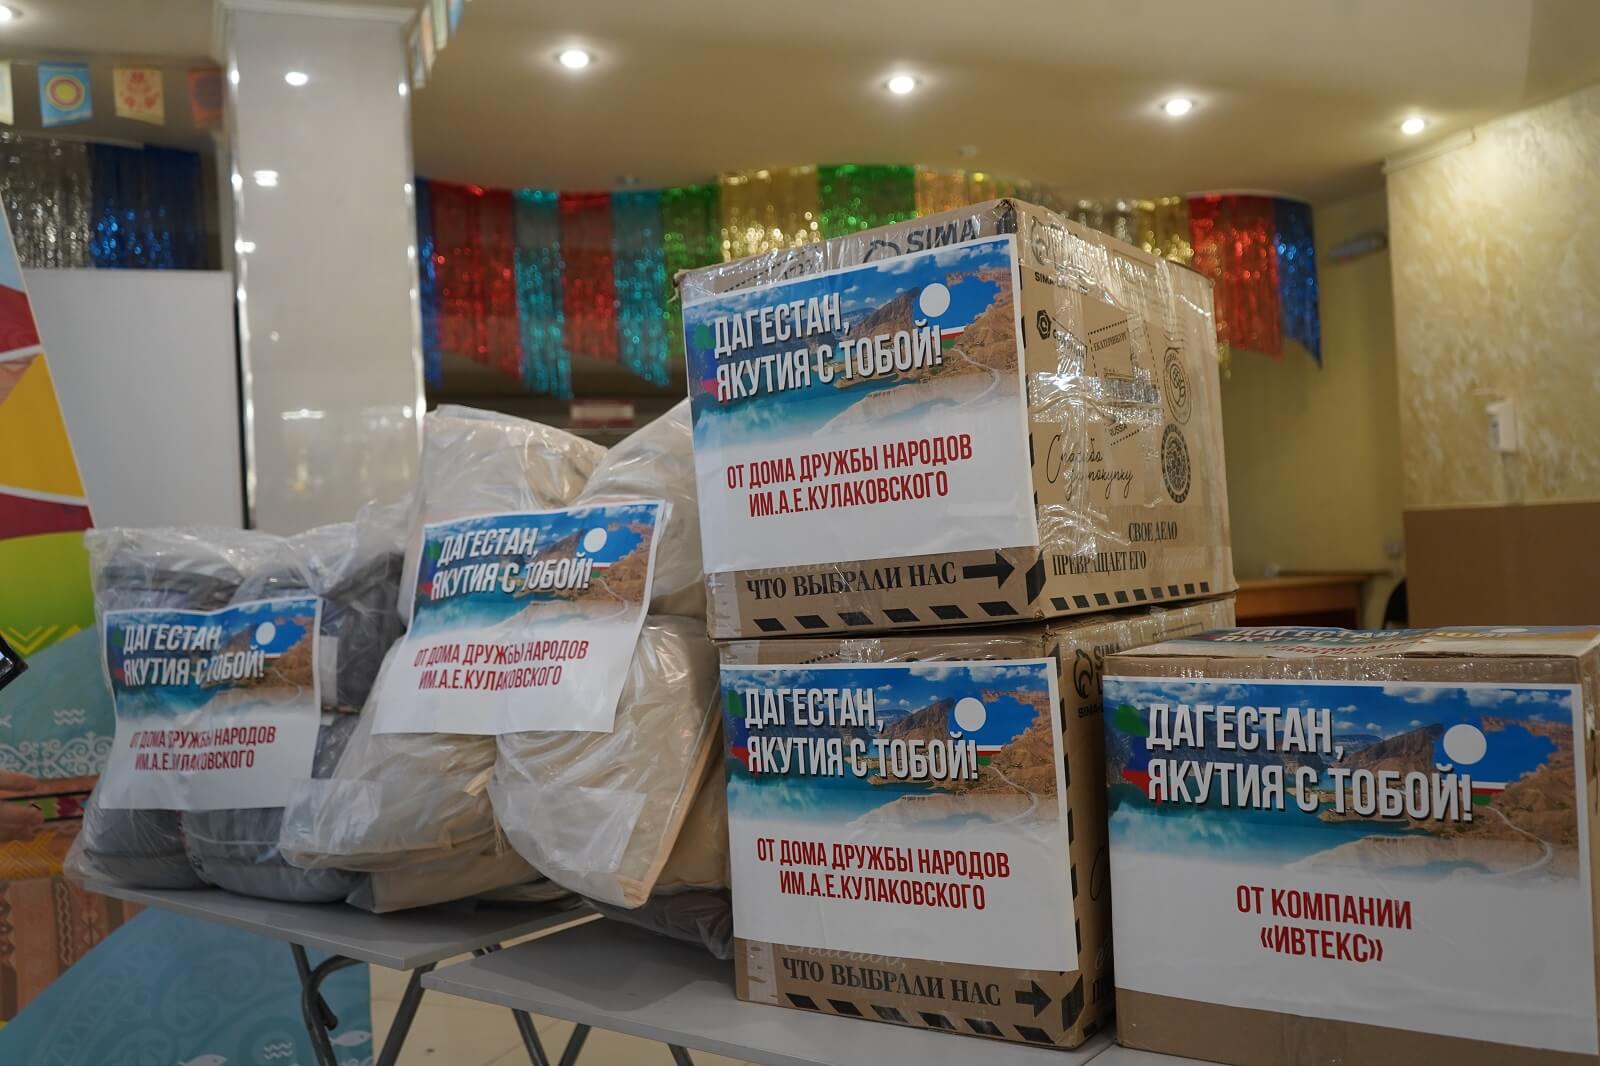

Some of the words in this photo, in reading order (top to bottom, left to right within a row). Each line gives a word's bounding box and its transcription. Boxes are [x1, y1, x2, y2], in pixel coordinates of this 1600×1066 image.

[714, 291, 851, 360] ДАГЕСТАН,
[716, 350, 812, 403] ЯКУТИЯ
[817, 344, 834, 384] С
[839, 318, 943, 379] ТОБОЙ!
[726, 464, 745, 490] ОТ
[748, 457, 796, 490] ДОМА
[799, 445, 879, 483] ДРУЖБЫ
[882, 433, 974, 468] НАРОДОВ
[748, 470, 950, 518] ИМ.А.Е.КУЛАКОВСКОГО
[436, 526, 540, 567] ДАГЕСТАН,
[1128, 521, 1153, 543] СВОЕ
[1154, 520, 1178, 544] ДЕЛО
[430, 563, 498, 600] ЯКУТИЯ
[501, 564, 520, 593] С
[521, 552, 594, 592] ТОБОЙ!
[747, 577, 787, 600] ЧТО
[794, 569, 903, 597] ВЫБРАЛИ
[908, 561, 957, 588] НАС
[1052, 551, 1127, 577] ПРЕВРАЩАЕТ
[1129, 550, 1147, 570] ЕГО
[123, 657, 191, 687] ЯКУТИЯ
[195, 659, 209, 685] С
[413, 648, 428, 668] ОТ
[426, 643, 460, 668] ДОМА
[462, 642, 523, 666] ДРУЖБЫ
[524, 640, 590, 663] НАРОДОВ
[417, 665, 564, 691] ИМ.А.Е.КУЛАКОВСКОГО
[744, 687, 884, 733] ДАГЕСТАН,
[1145, 702, 1345, 762] ДАГЕСТАН,
[213, 725, 277, 747] НАРОДОВ
[746, 735, 845, 777] ЯКУТИЯ
[851, 737, 867, 778] С
[874, 731, 980, 781] ТОБОЙ!
[1147, 759, 1286, 811] ЯКУТИЯ
[1295, 765, 1319, 814] С
[1327, 762, 1474, 824] ТОБОЙ!
[756, 837, 775, 863] ОТ
[779, 838, 828, 868] ДОМА
[830, 842, 914, 874] ДРУЖБЫ
[917, 849, 1011, 880] НАРОДОВ
[779, 870, 986, 911] ИМ.А.Е.КУЛАКОВСКОГО
[1236, 884, 1265, 916] ОТ
[1271, 888, 1413, 930] КОМПАНИИ
[1259, 924, 1385, 963] «ИВТЕКС»
[781, 957, 825, 984] ЧТО
[831, 961, 944, 1001] ВЫБРАЛИ
[951, 979, 1002, 1008] НАС
